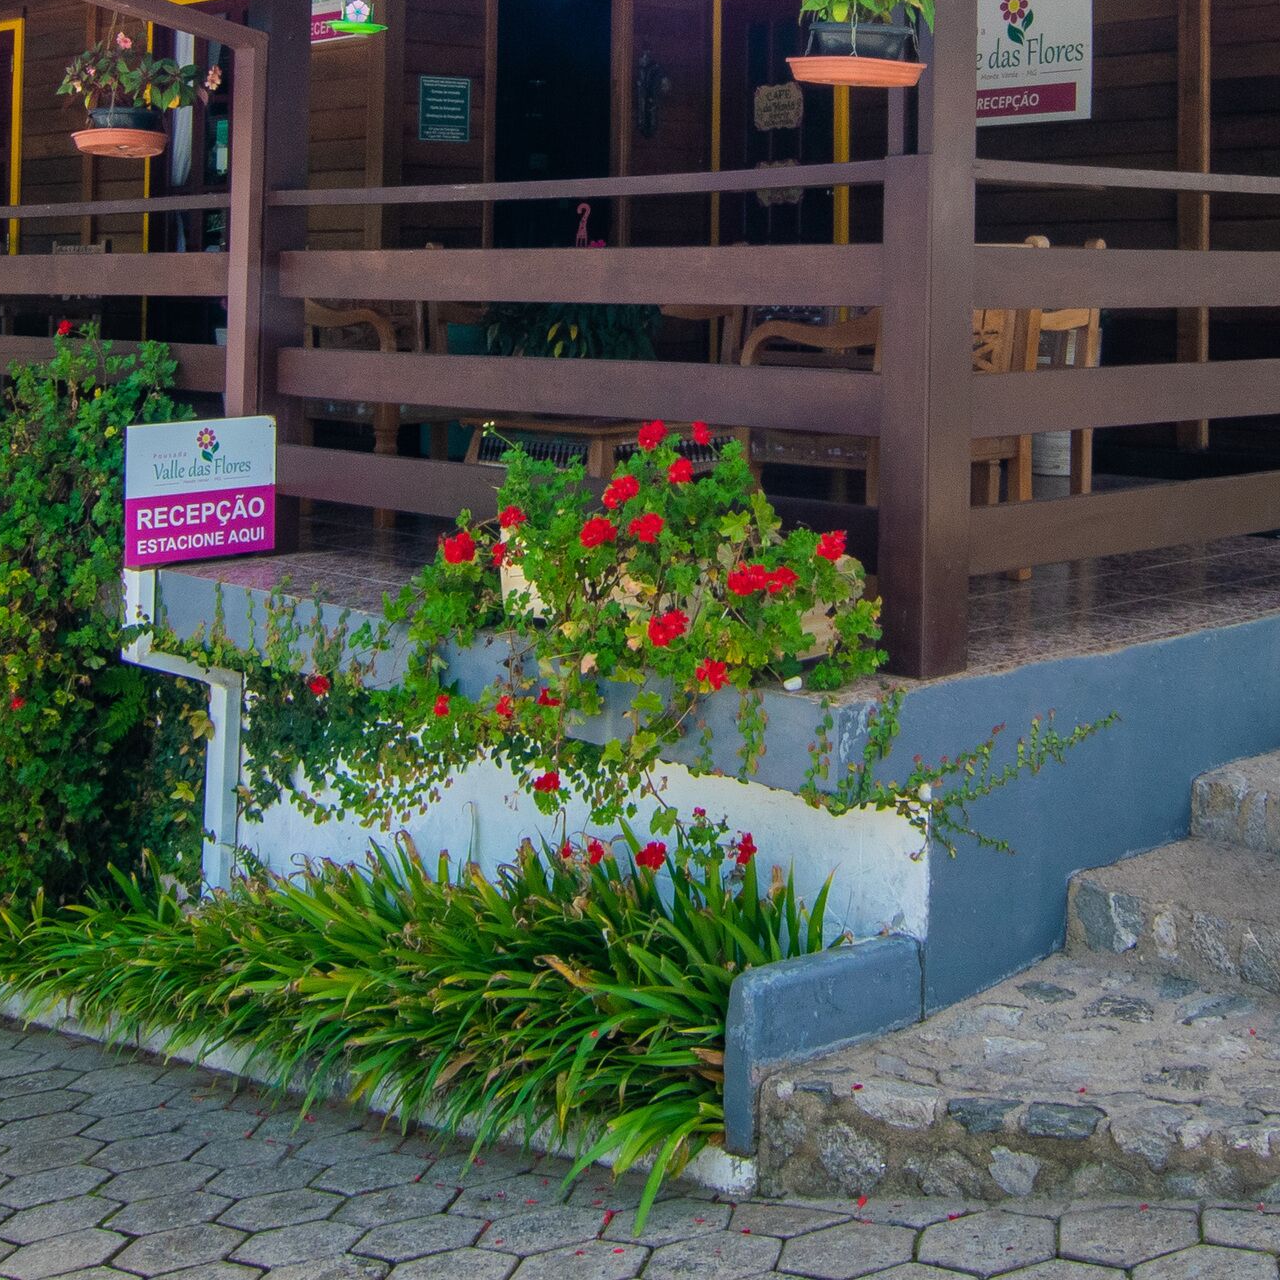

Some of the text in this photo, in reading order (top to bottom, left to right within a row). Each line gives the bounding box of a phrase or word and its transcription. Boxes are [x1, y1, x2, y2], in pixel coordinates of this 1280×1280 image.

[988, 38, 1020, 69] das
[1026, 33, 1084, 66] Flores
[976, 91, 1040, 111] RECEPÇÃO
[153, 455, 252, 480] Valle das Flores
[136, 494, 266, 531] RECEPÇÃO
[136, 526, 265, 555] ESTACIONE AQUI
